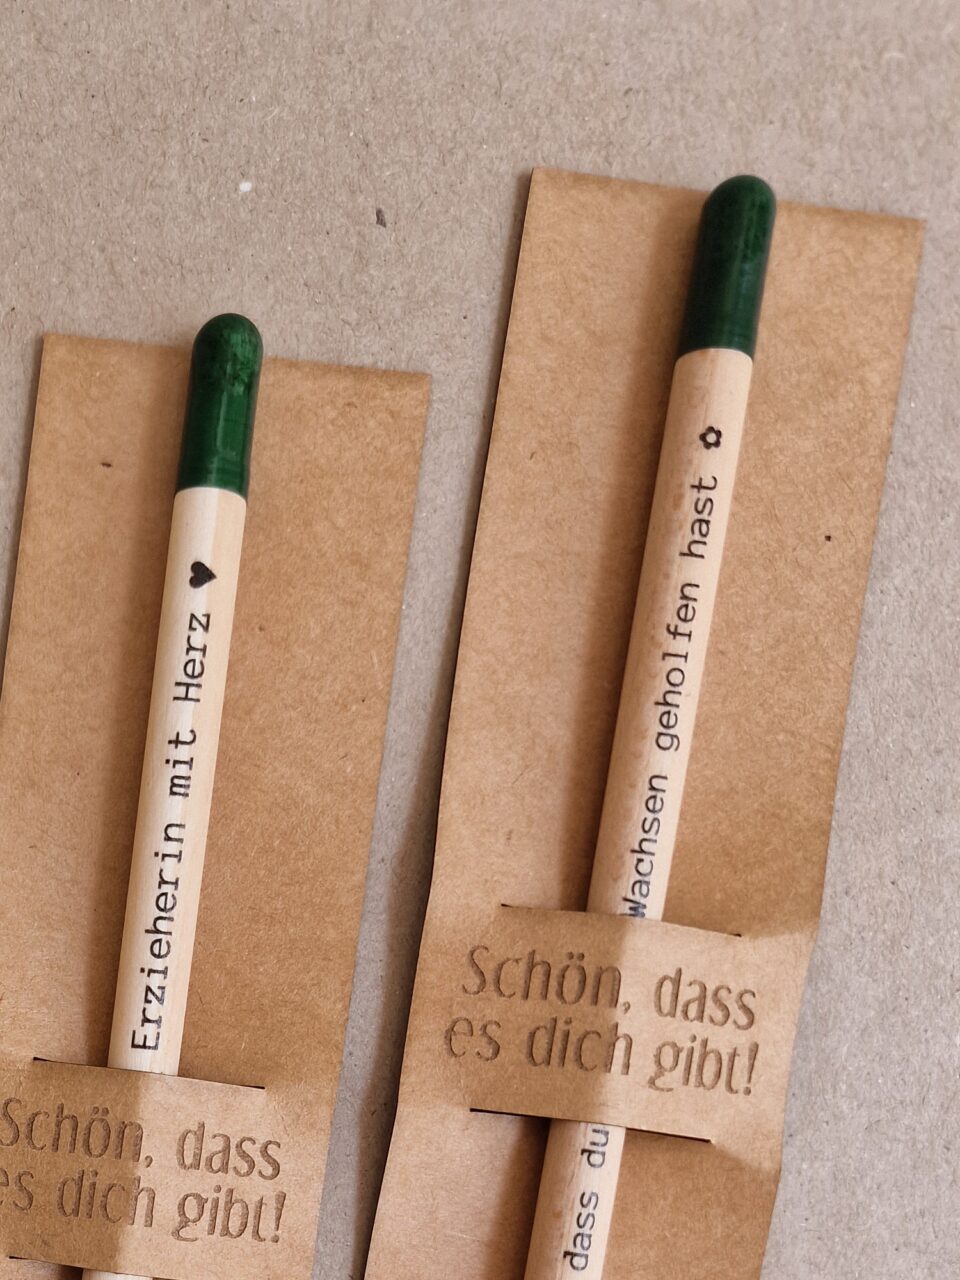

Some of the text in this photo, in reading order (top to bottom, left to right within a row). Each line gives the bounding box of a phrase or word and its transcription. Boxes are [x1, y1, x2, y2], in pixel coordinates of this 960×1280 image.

[619, 474, 718, 918] Wachsen geholfen hast
[131, 612, 211, 1052] Erzieherin mit Herz
[462, 945, 757, 1031] Schön, dass
[443, 1016, 759, 1097] es dich gibt!
[176, 1121, 281, 1181] dass
[580, 1128, 610, 1168] du
[57, 1169, 156, 1228] dich
[171, 1184, 287, 1244] gibt!
[563, 1190, 598, 1272] dass
